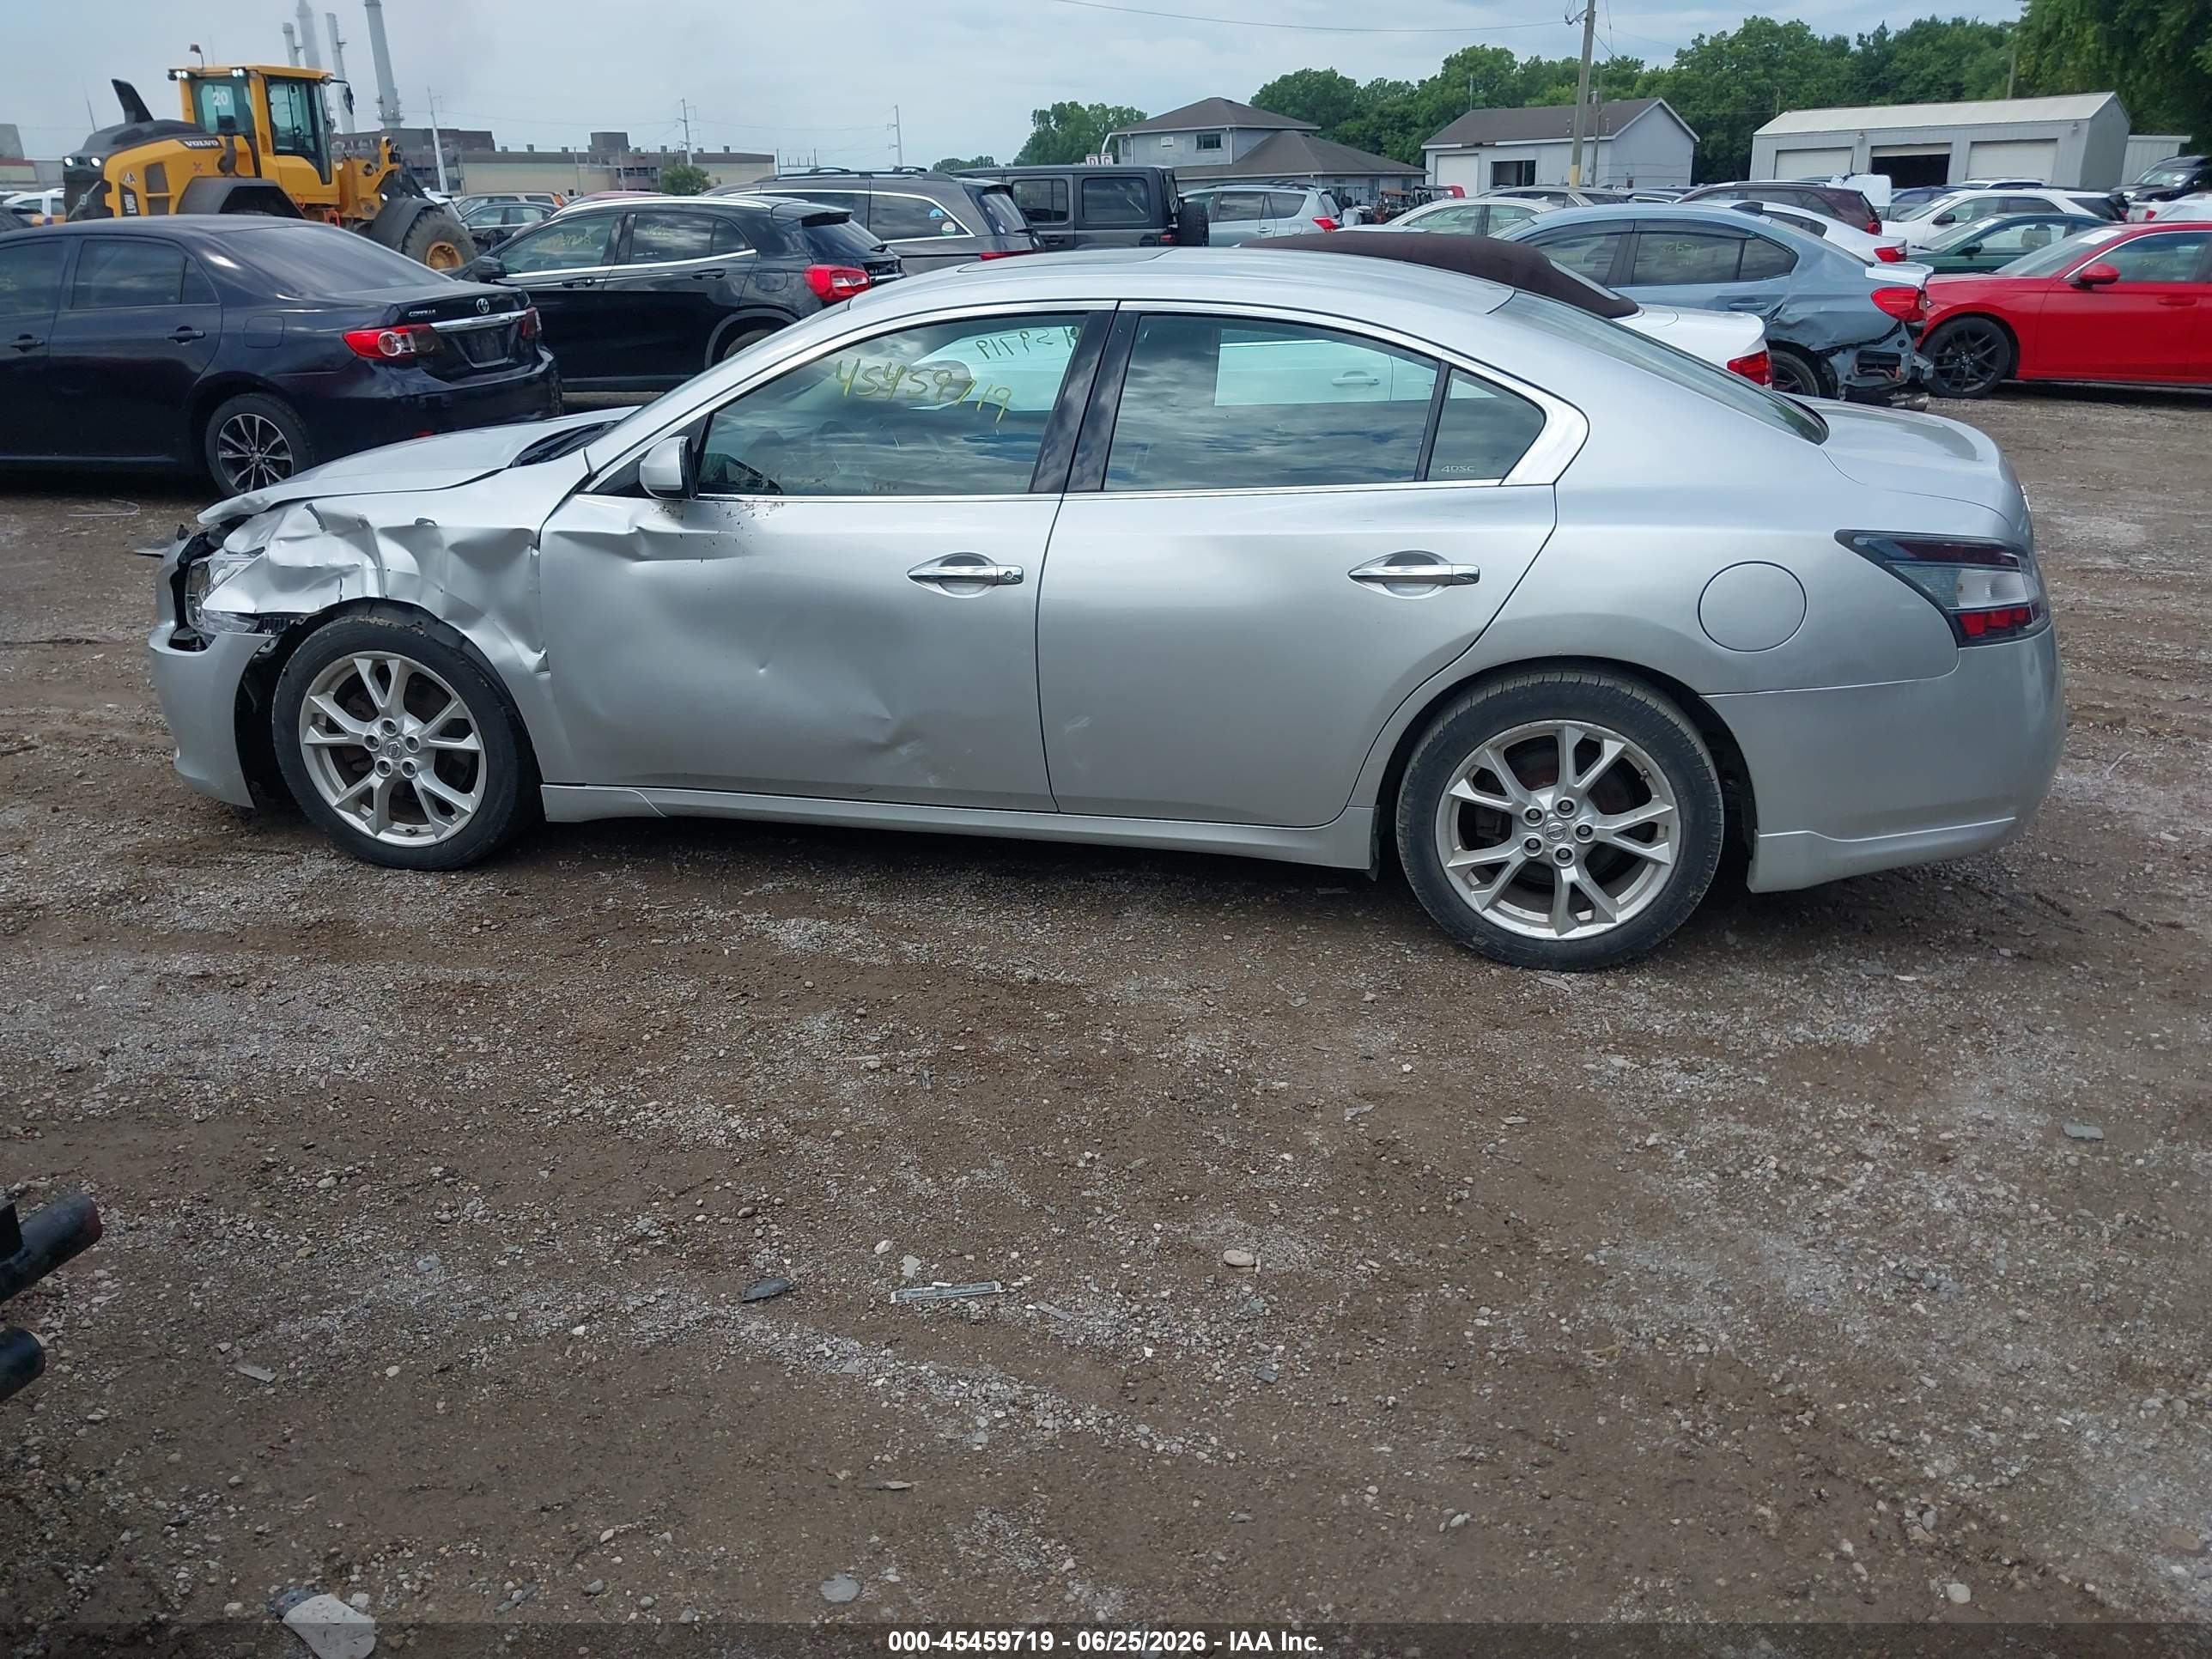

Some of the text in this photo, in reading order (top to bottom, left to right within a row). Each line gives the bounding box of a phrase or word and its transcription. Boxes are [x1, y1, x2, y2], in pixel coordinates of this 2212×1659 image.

[214, 92, 228, 106] 20
[184, 139, 220, 148] VOLVO
[836, 357, 1013, 423] 45459719
